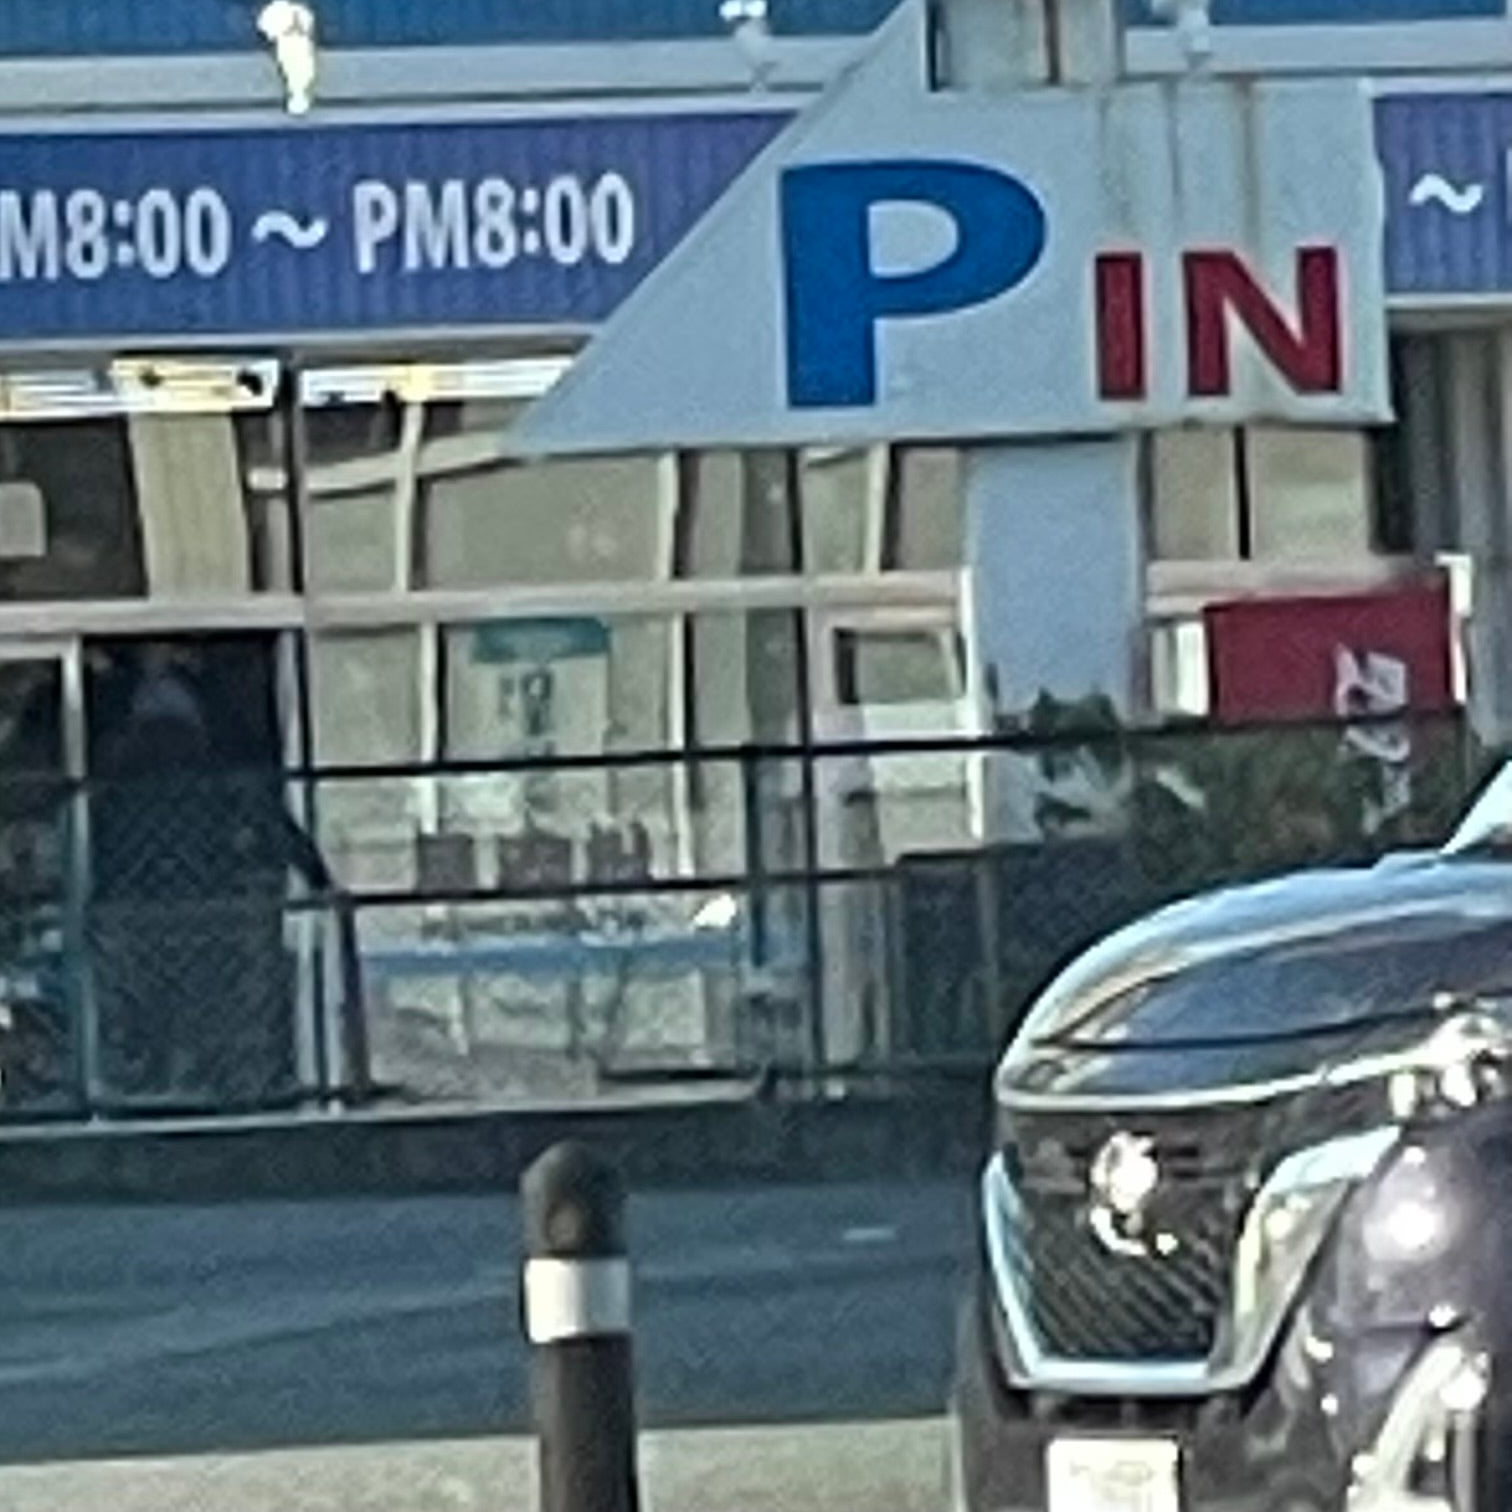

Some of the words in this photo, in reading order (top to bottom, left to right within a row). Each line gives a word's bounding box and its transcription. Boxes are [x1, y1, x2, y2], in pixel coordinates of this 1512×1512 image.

[353, 171, 635, 274] PM8:00
[778, 158, 1047, 410] P
[1094, 245, 1342, 401] IN
